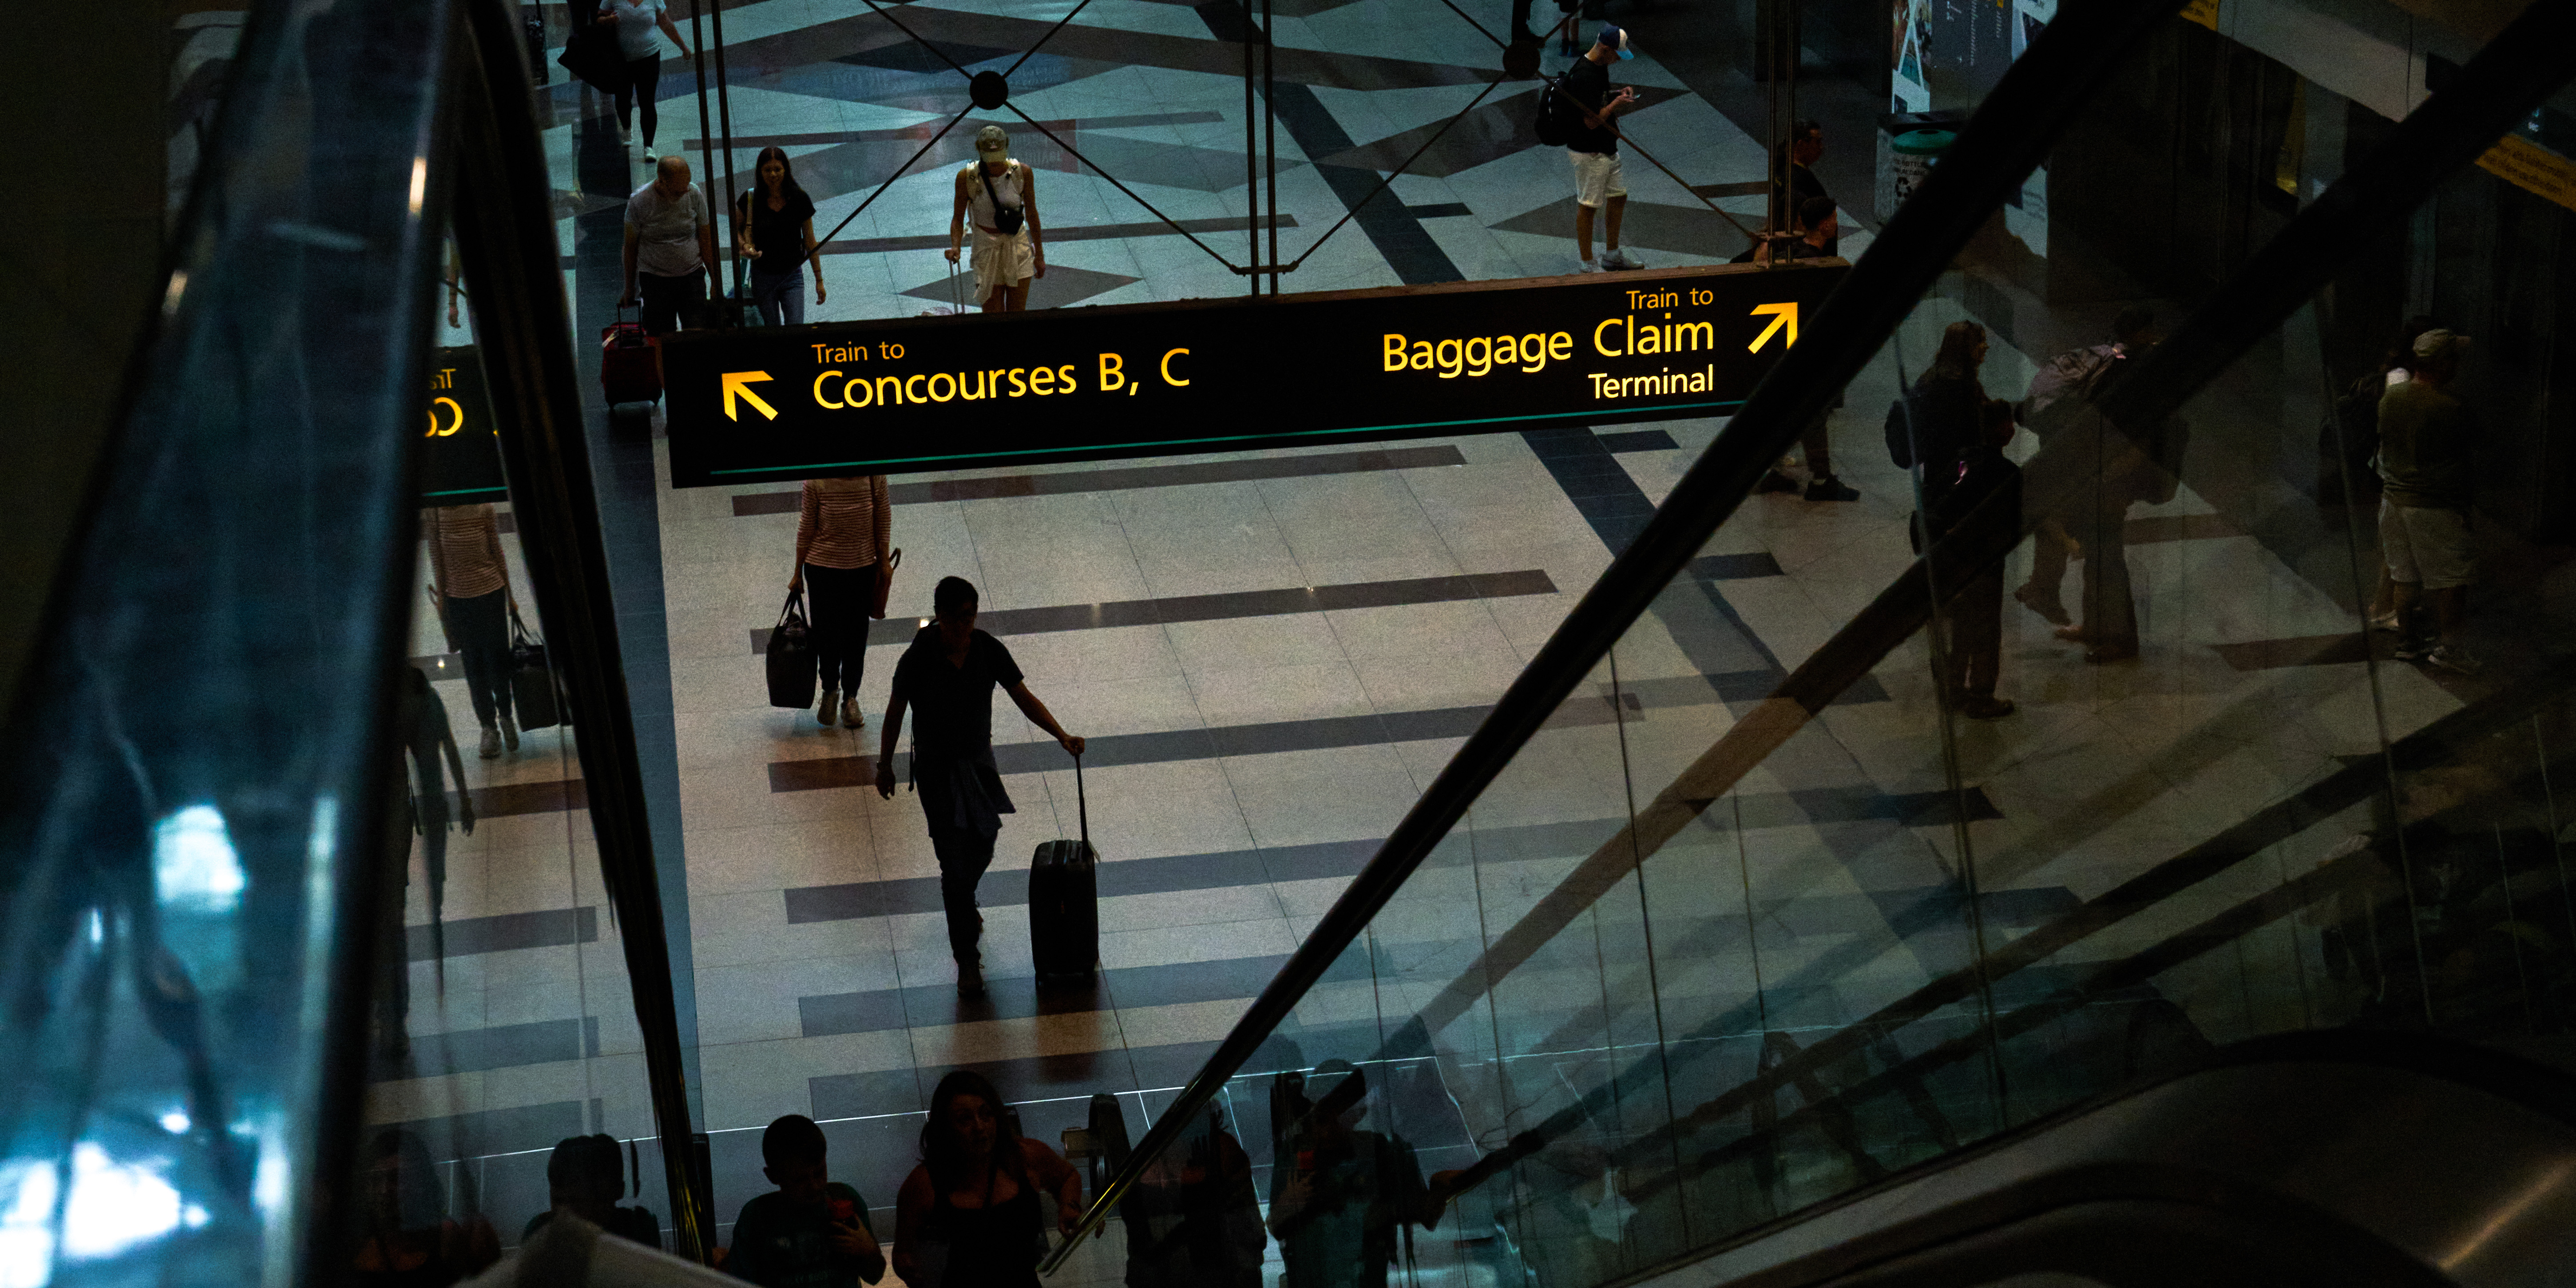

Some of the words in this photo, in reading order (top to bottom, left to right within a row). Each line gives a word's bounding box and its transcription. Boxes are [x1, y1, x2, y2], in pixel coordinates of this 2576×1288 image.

[1625, 287, 1678, 310] Train
[1689, 288, 1714, 306] to
[811, 341, 868, 364] Train
[878, 341, 905, 361] to
[1383, 330, 1573, 378] Baggage
[1593, 312, 1714, 358] Claim
[813, 364, 1078, 410] Concourses
[1098, 352, 1139, 396] B,
[1160, 347, 1190, 387] C
[1587, 363, 1714, 400] Terminal
